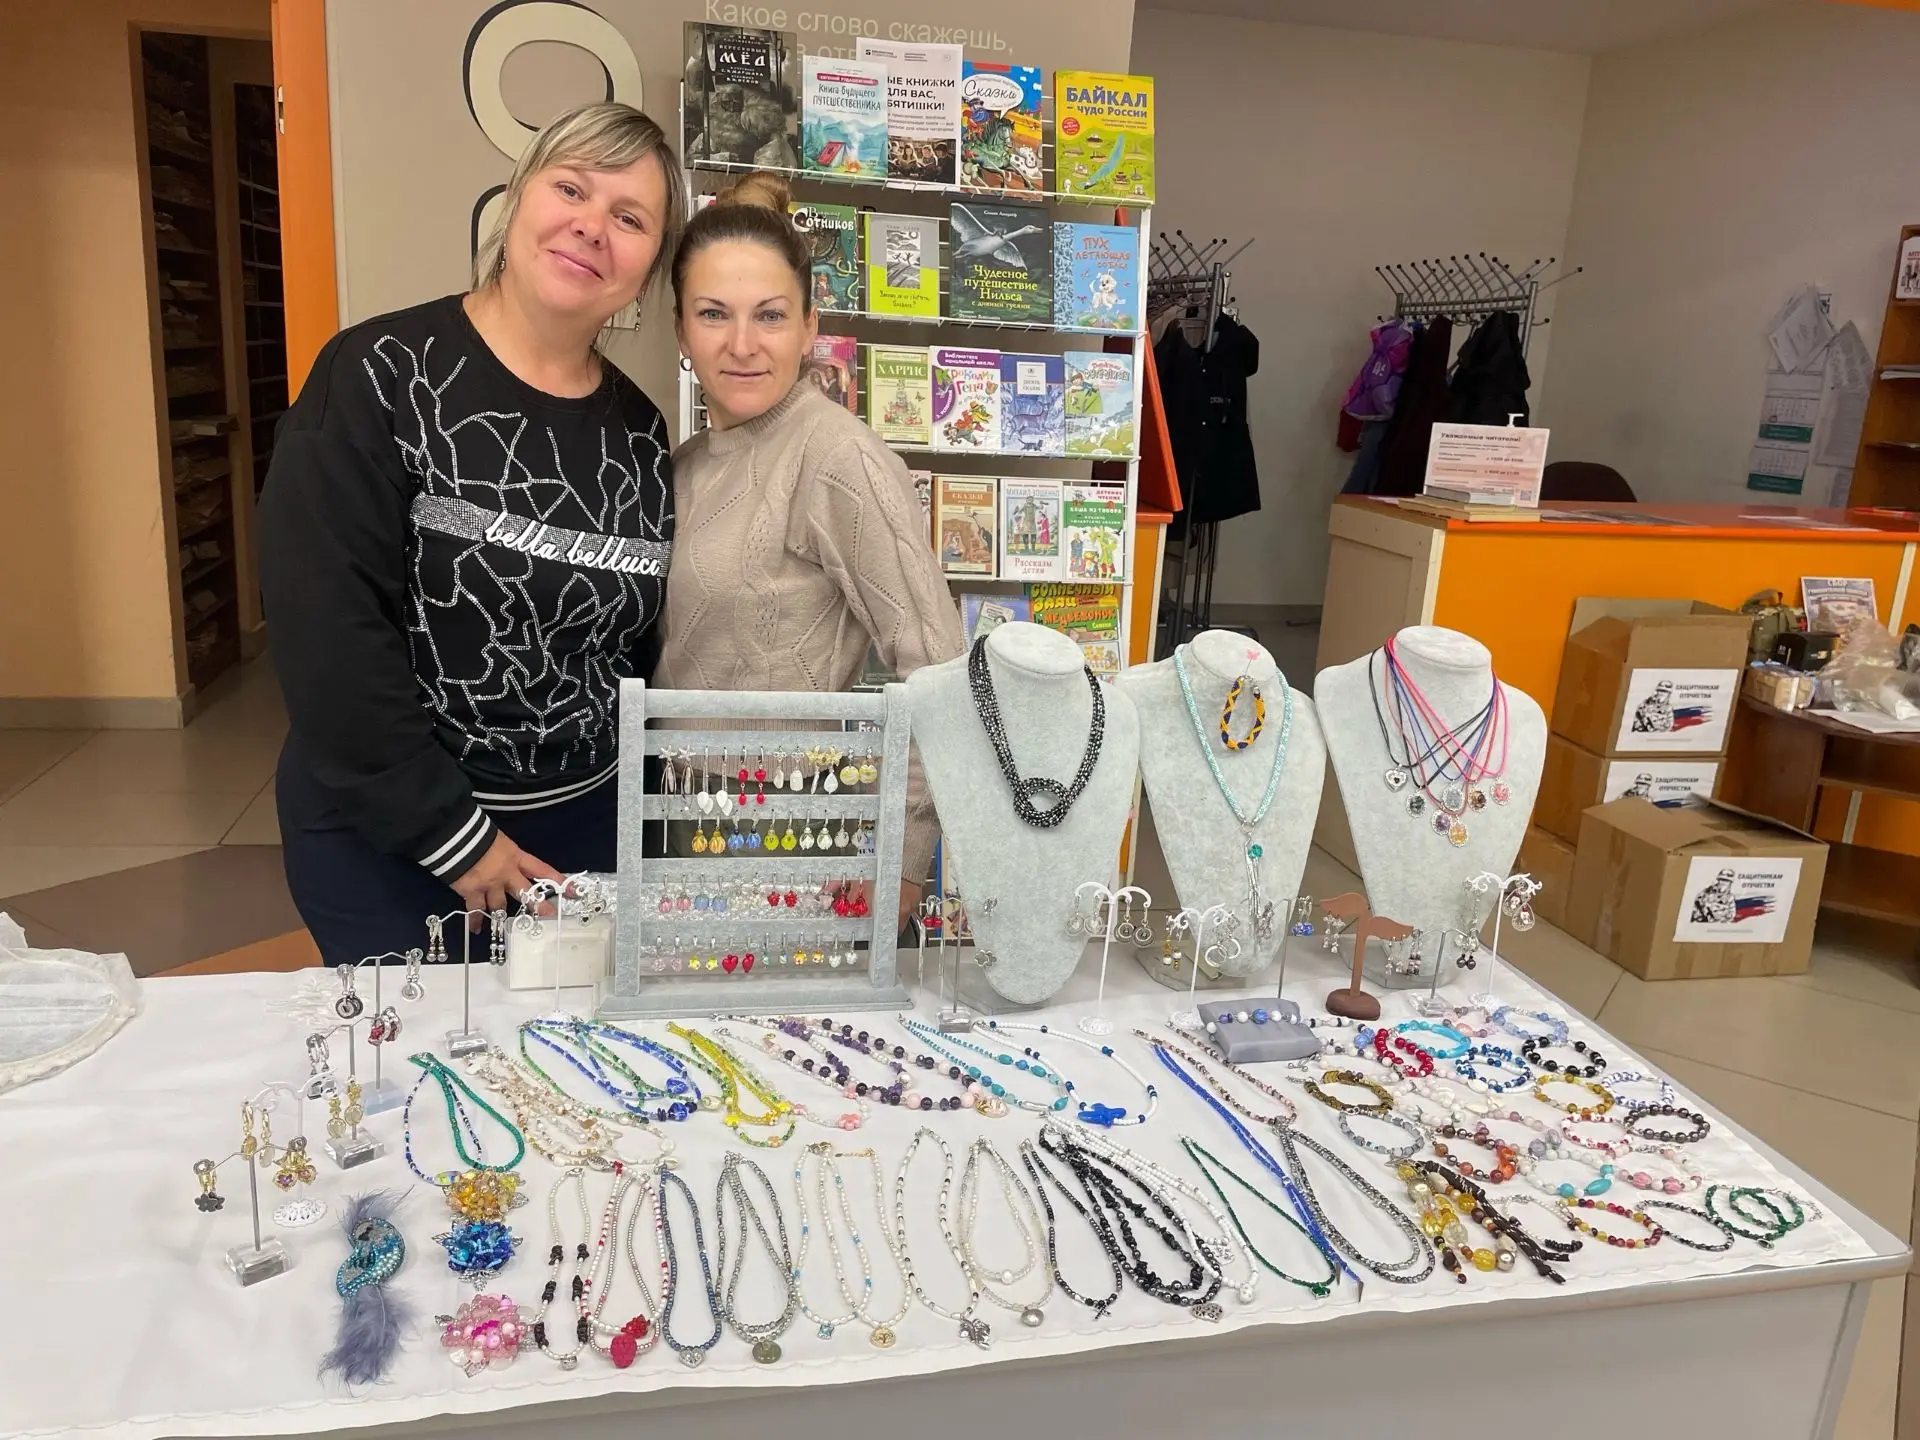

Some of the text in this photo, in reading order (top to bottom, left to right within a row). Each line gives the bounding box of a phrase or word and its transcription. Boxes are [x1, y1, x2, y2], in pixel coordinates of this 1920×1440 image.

[705, 0, 1014, 55] Какое слово скажешь,
[719, 51, 766, 67] МЁД
[905, 77, 955, 88] КНИЖКИ
[964, 79, 1017, 99] Сказки
[818, 84, 876, 99] Книга будущего
[910, 89, 936, 100] ВАС,
[1066, 84, 1148, 108] БАЙКАЛ
[812, 95, 881, 111] ПУТЕШЕСТВЕННИКА
[887, 99, 946, 111] БЯТИШКИ!
[1107, 105, 1148, 118] России
[973, 264, 1028, 280] Чудесное
[964, 278, 1038, 291] путешествие
[979, 287, 1023, 302] Нильса
[878, 364, 926, 377] ХАРРИС
[956, 380, 984, 395] Гена
[952, 492, 984, 501] СКАЗКИ
[484, 511, 560, 561] bella
[1014, 557, 1052, 568] Рассказы
[1033, 596, 1077, 612] ЗАЯЦ
